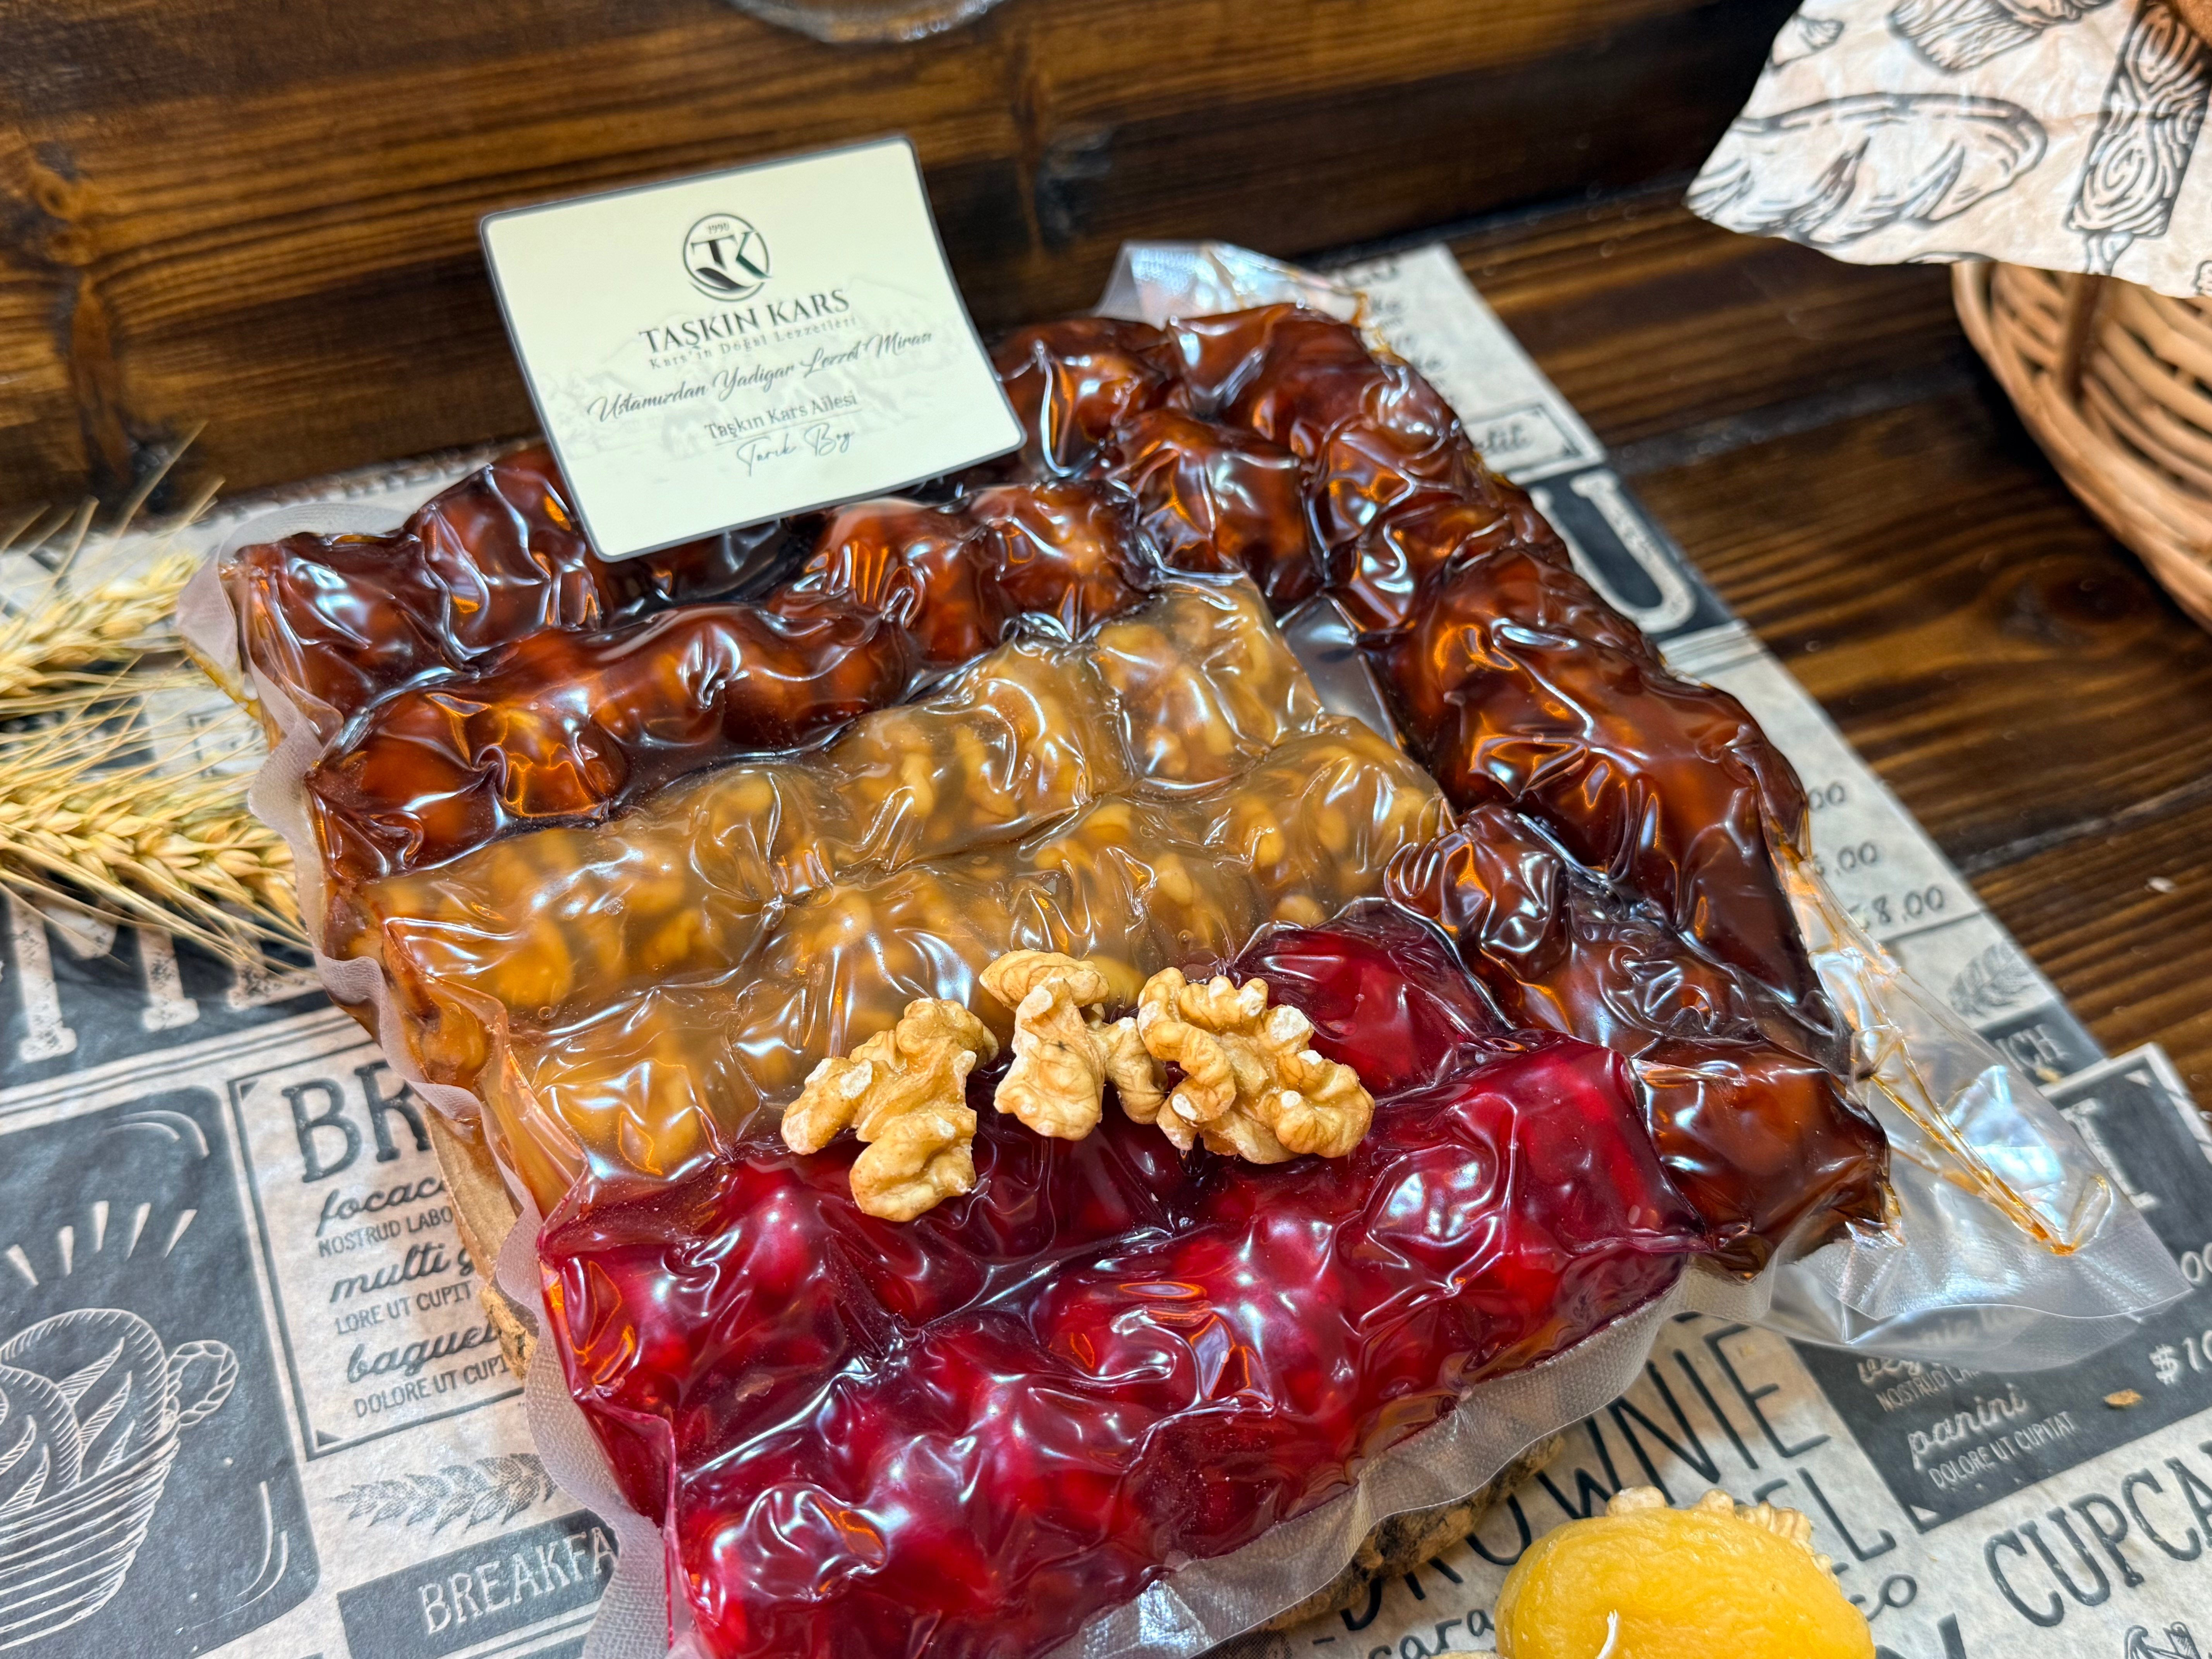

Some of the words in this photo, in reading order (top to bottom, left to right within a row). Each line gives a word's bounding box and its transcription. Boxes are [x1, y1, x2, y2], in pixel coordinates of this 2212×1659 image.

[638, 307, 761, 353] TAŞKIN
[766, 288, 850, 328] KARS
[712, 363, 795, 402] Yadigar
[800, 340, 862, 379] Lezzet
[765, 403, 808, 425] Kars
[811, 390, 857, 415] Ailesi
[281, 1060, 431, 1184] BR
[316, 1176, 447, 1237] focac
[318, 1220, 401, 1258] NOSTRUD
[405, 1206, 454, 1233] LABO
[329, 1241, 450, 1304] multi
[335, 1304, 386, 1335] LORE
[386, 1296, 411, 1319] UT
[354, 1377, 431, 1418] DOLORE
[433, 1369, 459, 1393] UT
[464, 1355, 510, 1385] CUPI
[1907, 1382, 2029, 1471] panini
[1928, 1446, 1996, 1491] DOLORE
[1989, 1436, 2017, 1463] UT
[1984, 1440, 2212, 1627] CUPCA
[418, 1527, 619, 1635] BREAKFA
